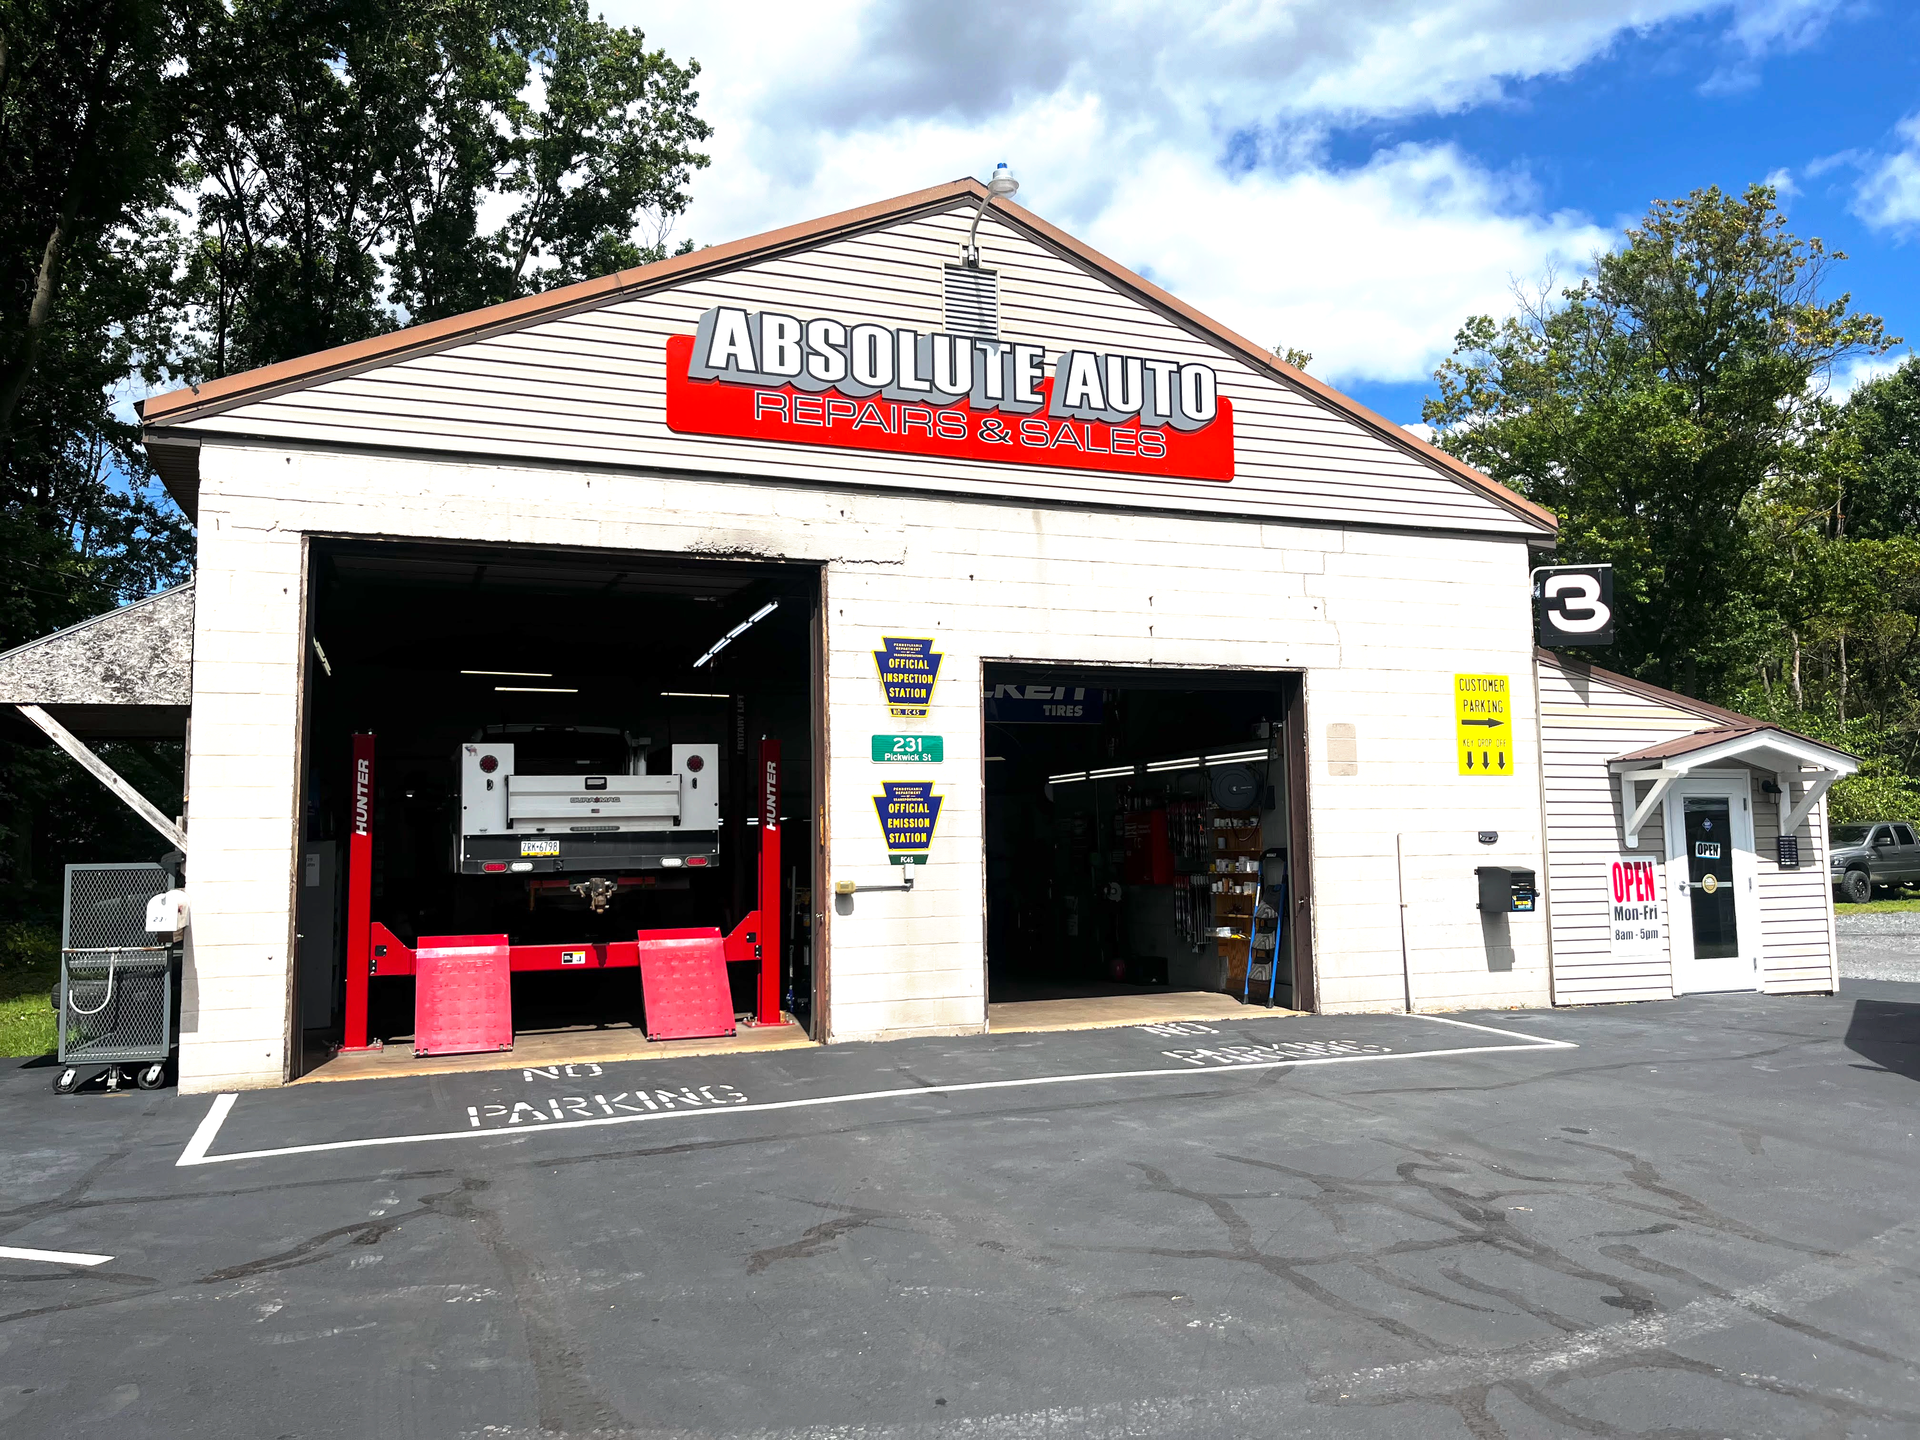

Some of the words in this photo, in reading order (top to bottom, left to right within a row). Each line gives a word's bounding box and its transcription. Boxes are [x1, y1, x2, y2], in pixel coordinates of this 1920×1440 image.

[698, 306, 1045, 408] ABSOLUTE
[1058, 350, 1217, 426] AUTO
[754, 391, 966, 440] REPAIRS
[977, 415, 1012, 444] &
[1020, 419, 1167, 459] SALES
[1545, 574, 1611, 633] 3
[888, 658, 930, 670] OFFICIAL
[884, 673, 934, 684] INSPECTION
[1459, 678, 1505, 692] CUSTOMER
[889, 687, 927, 698] STATION
[1043, 705, 1083, 716] TIRES
[1463, 699, 1504, 713] PARKING
[893, 737, 922, 752] 231
[1463, 739, 1474, 747] KEY
[1478, 739, 1492, 747] DROP
[884, 753, 920, 761] Pickwick
[356, 758, 369, 836] HUNTER
[766, 761, 776, 831] HUNTER
[888, 803, 930, 814] OFFICIAL
[888, 818, 930, 828] EMISSION
[889, 833, 927, 843] STATION
[1697, 843, 1719, 856] OPEN
[1612, 861, 1656, 904] OPEN
[1614, 904, 1658, 921] Mon-Fri
[1615, 929, 1634, 940] 8am
[1640, 928, 1658, 940] 5pm
[523, 1063, 603, 1082] NO
[467, 1084, 749, 1127] PARKING
